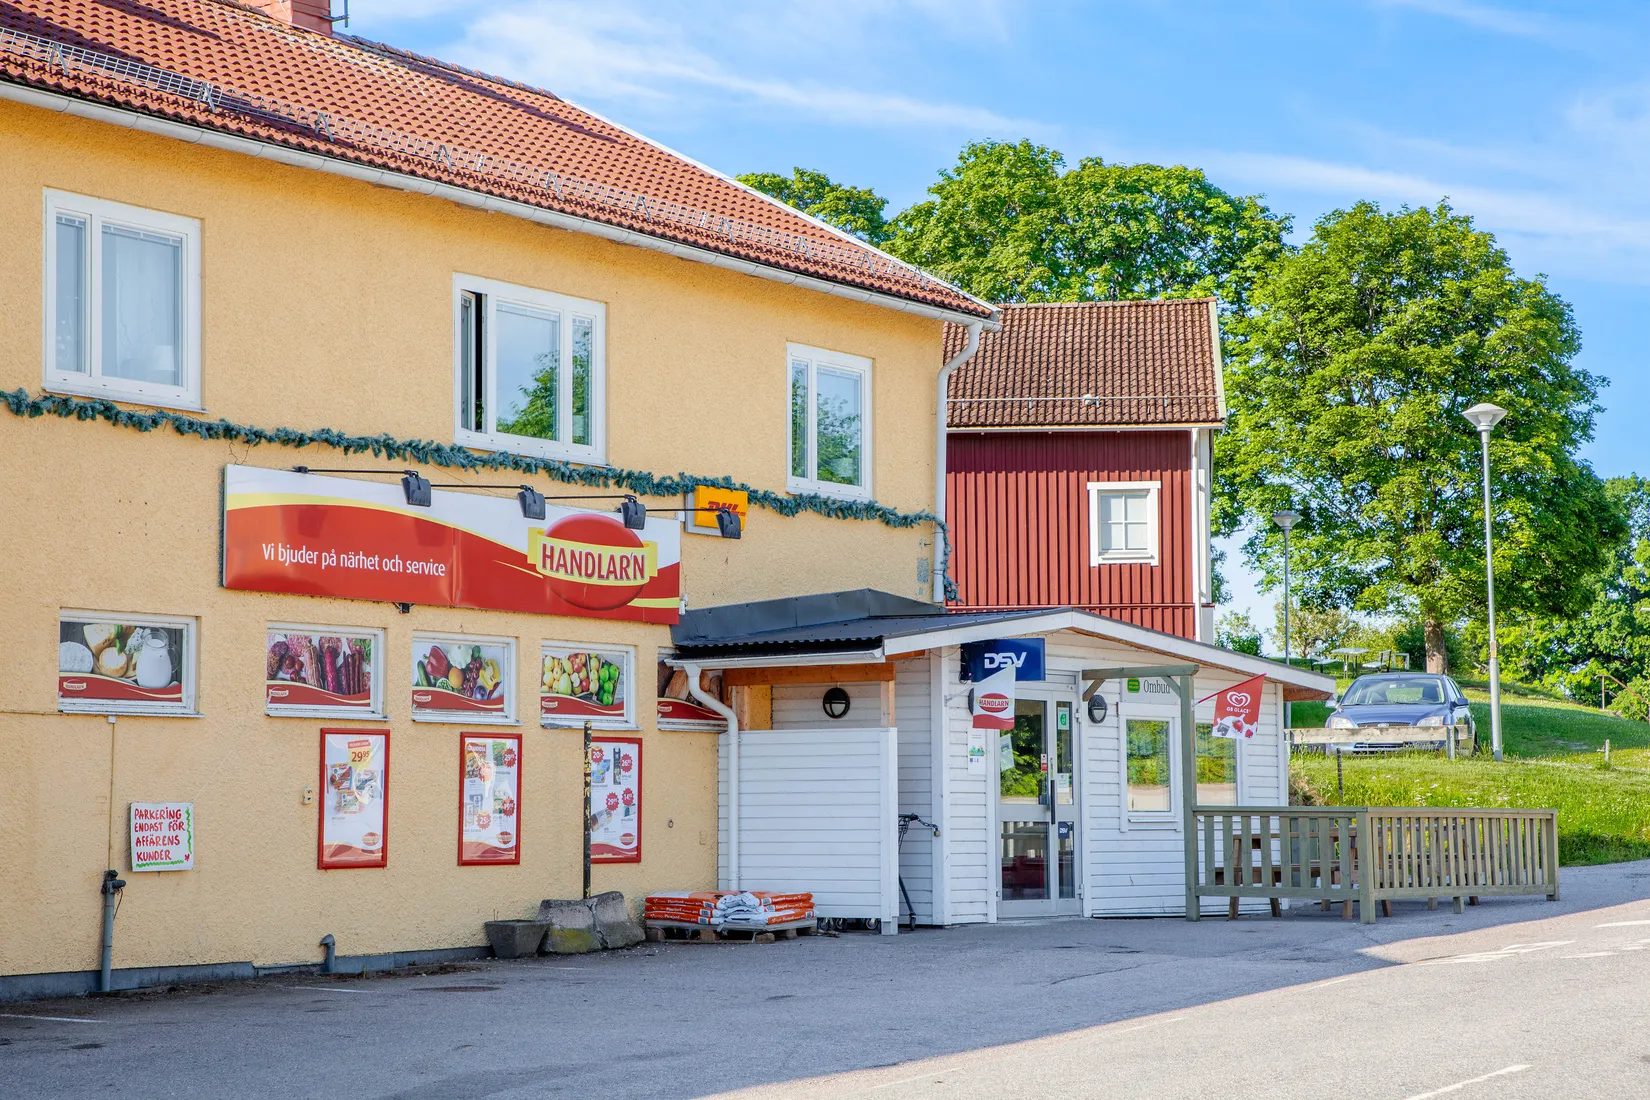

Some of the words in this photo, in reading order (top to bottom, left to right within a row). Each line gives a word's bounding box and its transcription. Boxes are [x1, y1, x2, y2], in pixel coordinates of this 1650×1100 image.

[262, 543, 275, 561] Vi
[278, 543, 318, 567] bjuder
[321, 549, 337, 570] på
[340, 551, 379, 571] närhet
[382, 555, 403, 573] och
[406, 559, 446, 577] service
[984, 652, 1027, 669] DSV
[134, 822, 163, 833] ENDAST
[168, 819, 186, 832] FÖR
[135, 833, 181, 847] AFFÄRENS
[136, 849, 172, 862] KUNDER
